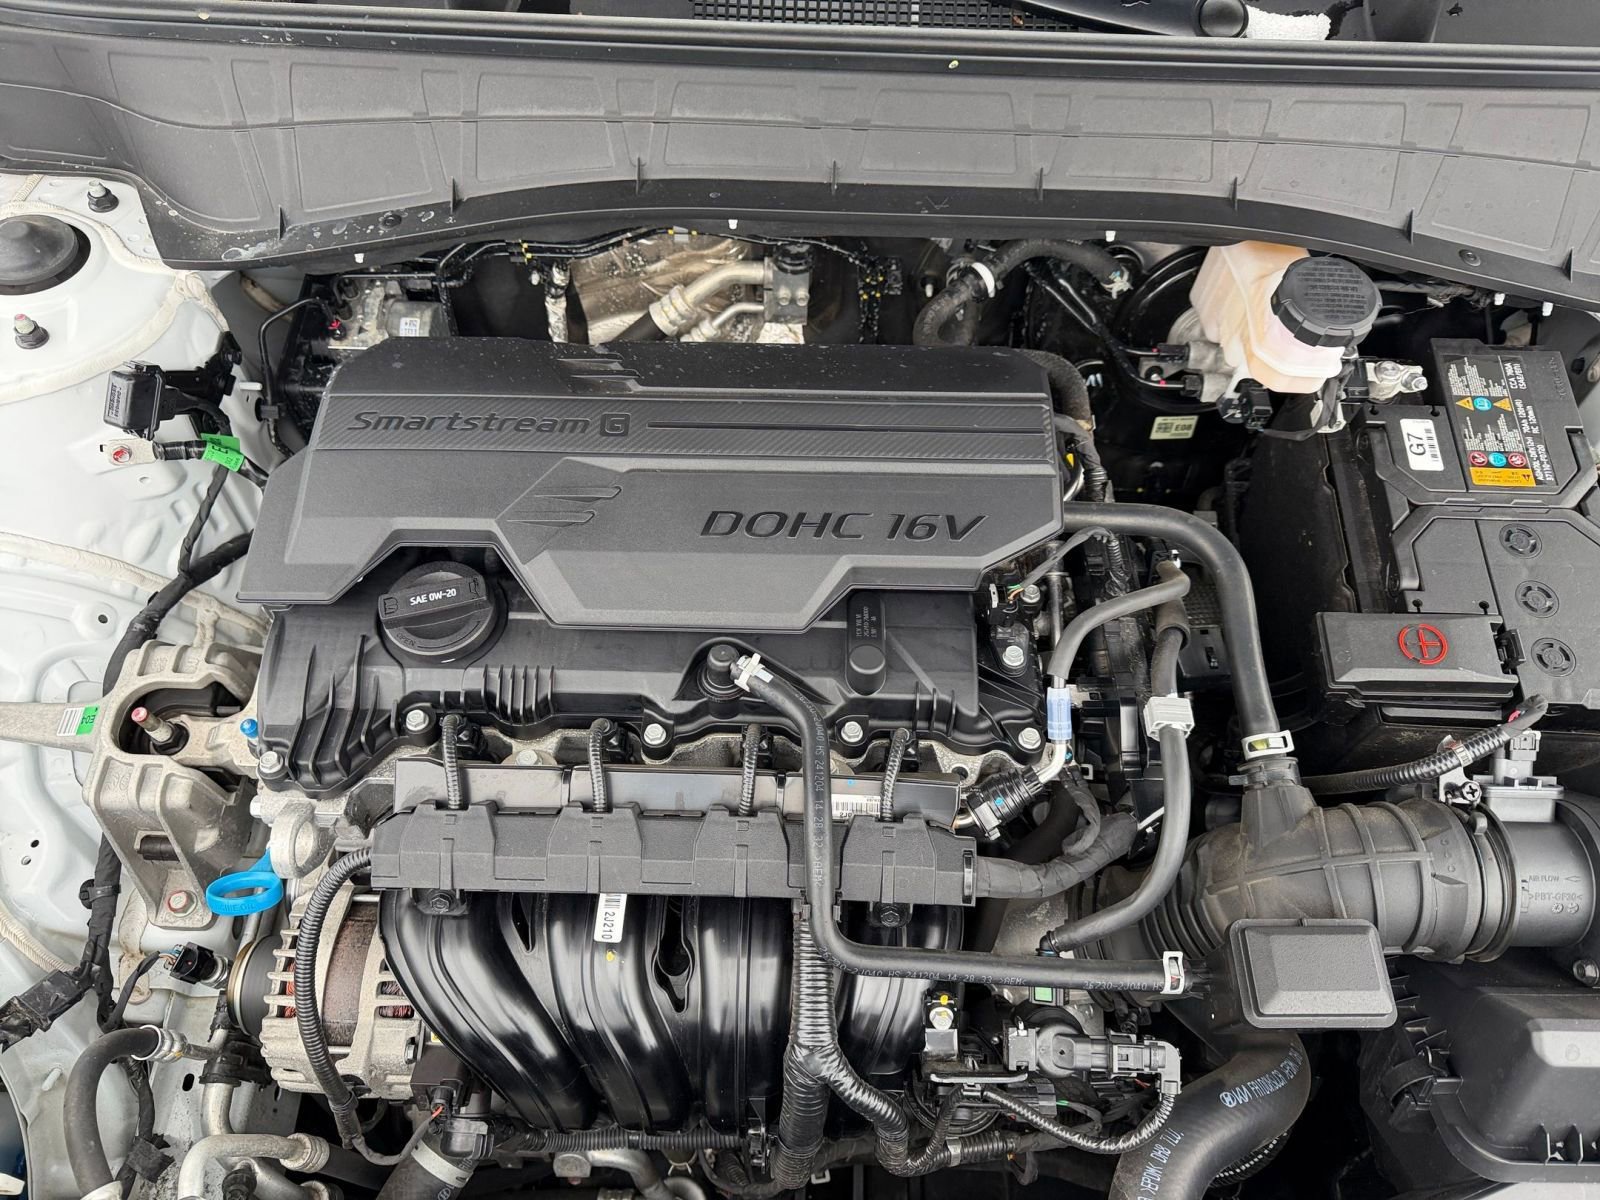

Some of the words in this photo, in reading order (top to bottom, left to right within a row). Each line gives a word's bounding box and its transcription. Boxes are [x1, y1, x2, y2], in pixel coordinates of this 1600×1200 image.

[348, 411, 591, 434] Smartstream
[1406, 432, 1426, 456] G7
[700, 510, 874, 540] DOHC
[887, 512, 989, 541] 16V
[409, 594, 427, 606] SAE
[428, 588, 457, 602] 0W-20
[396, 632, 416, 647] OPEN
[815, 745, 825, 756] HS
[814, 759, 824, 792] 241204
[1529, 874, 1540, 882] AIR
[1541, 874, 1560, 882] FLOW
[601, 911, 616, 940] 2J210
[888, 970, 901, 978] HS
[905, 971, 940, 980] 241204
[1082, 981, 1147, 991] 26730-2J040
